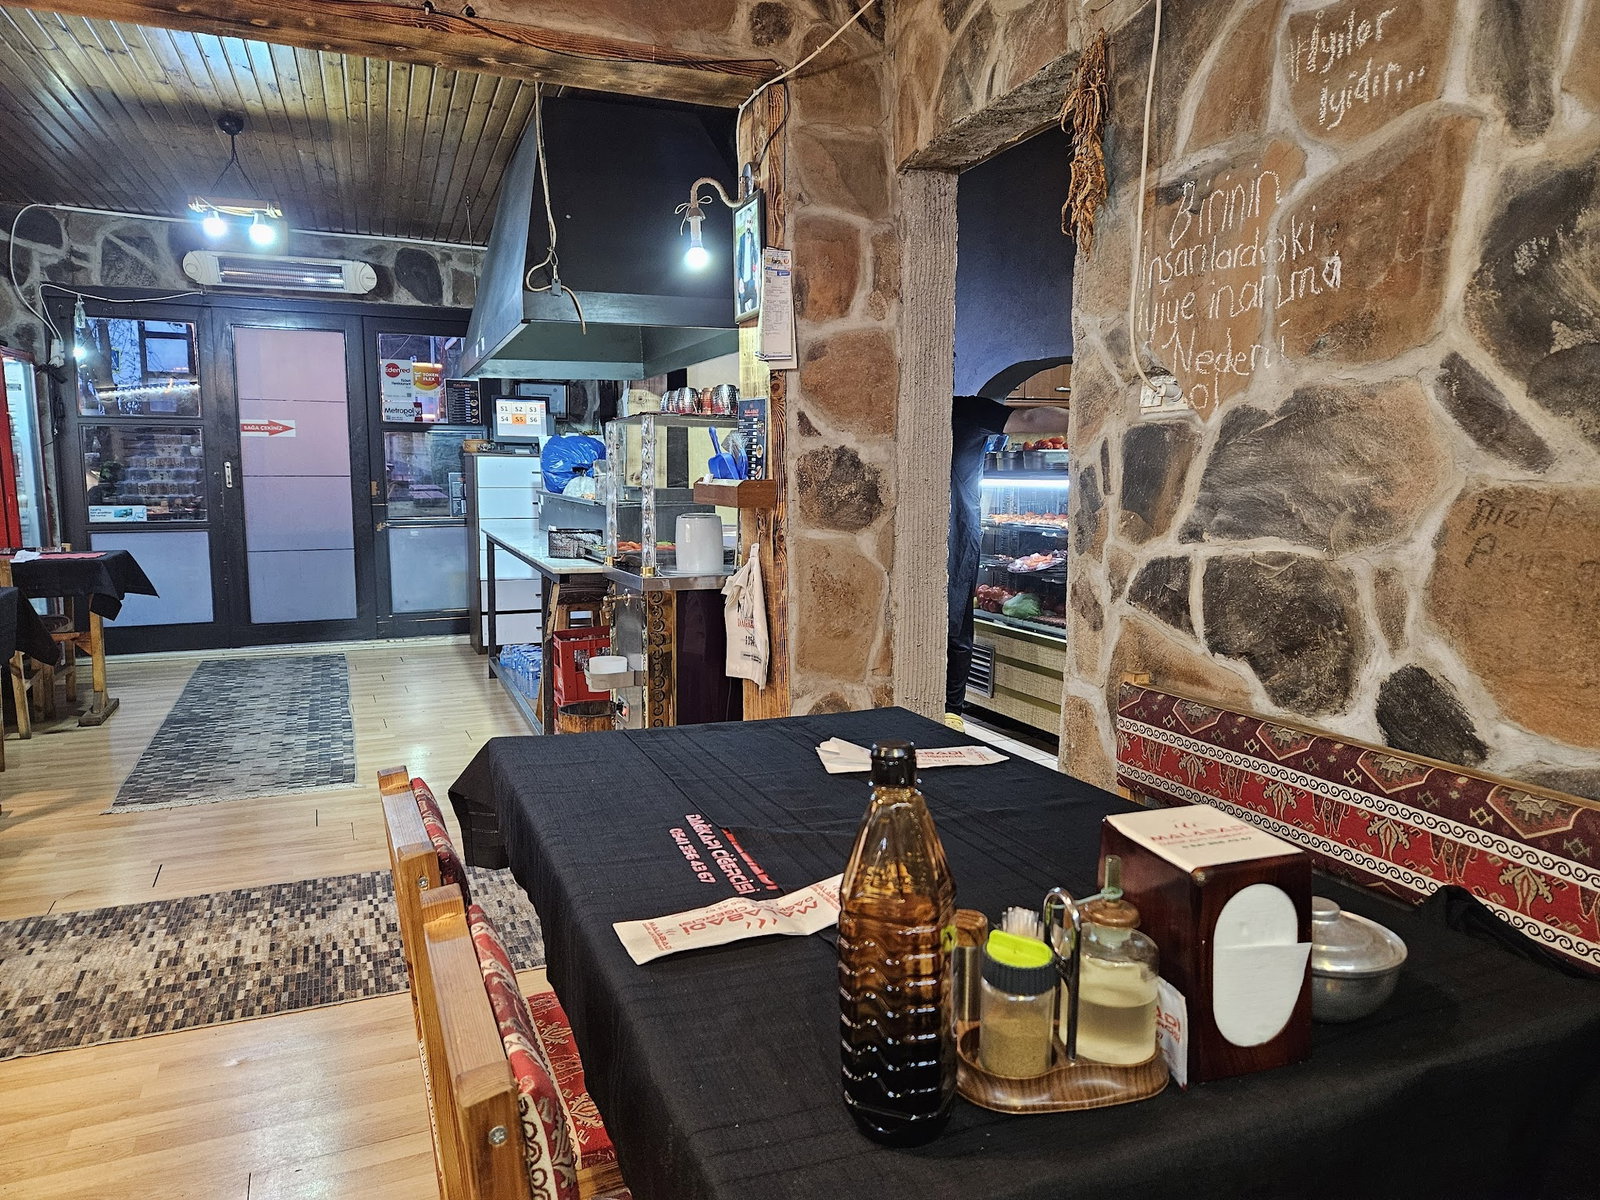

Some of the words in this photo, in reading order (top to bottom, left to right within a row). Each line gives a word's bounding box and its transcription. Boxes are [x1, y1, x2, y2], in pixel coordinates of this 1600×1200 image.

[1169, 163, 1281, 248] Birinin
[385, 366, 411, 374] Edenred
[1189, 372, 1220, 410] ol
[384, 407, 414, 416] Metropol
[669, 827, 691, 845] 0541
[679, 844, 701, 861] 356
[685, 813, 723, 850] DAĞKAPI
[711, 849, 761, 895] CİĞERCİSİ
[690, 860, 708, 873] 43
[697, 871, 717, 883] 67
